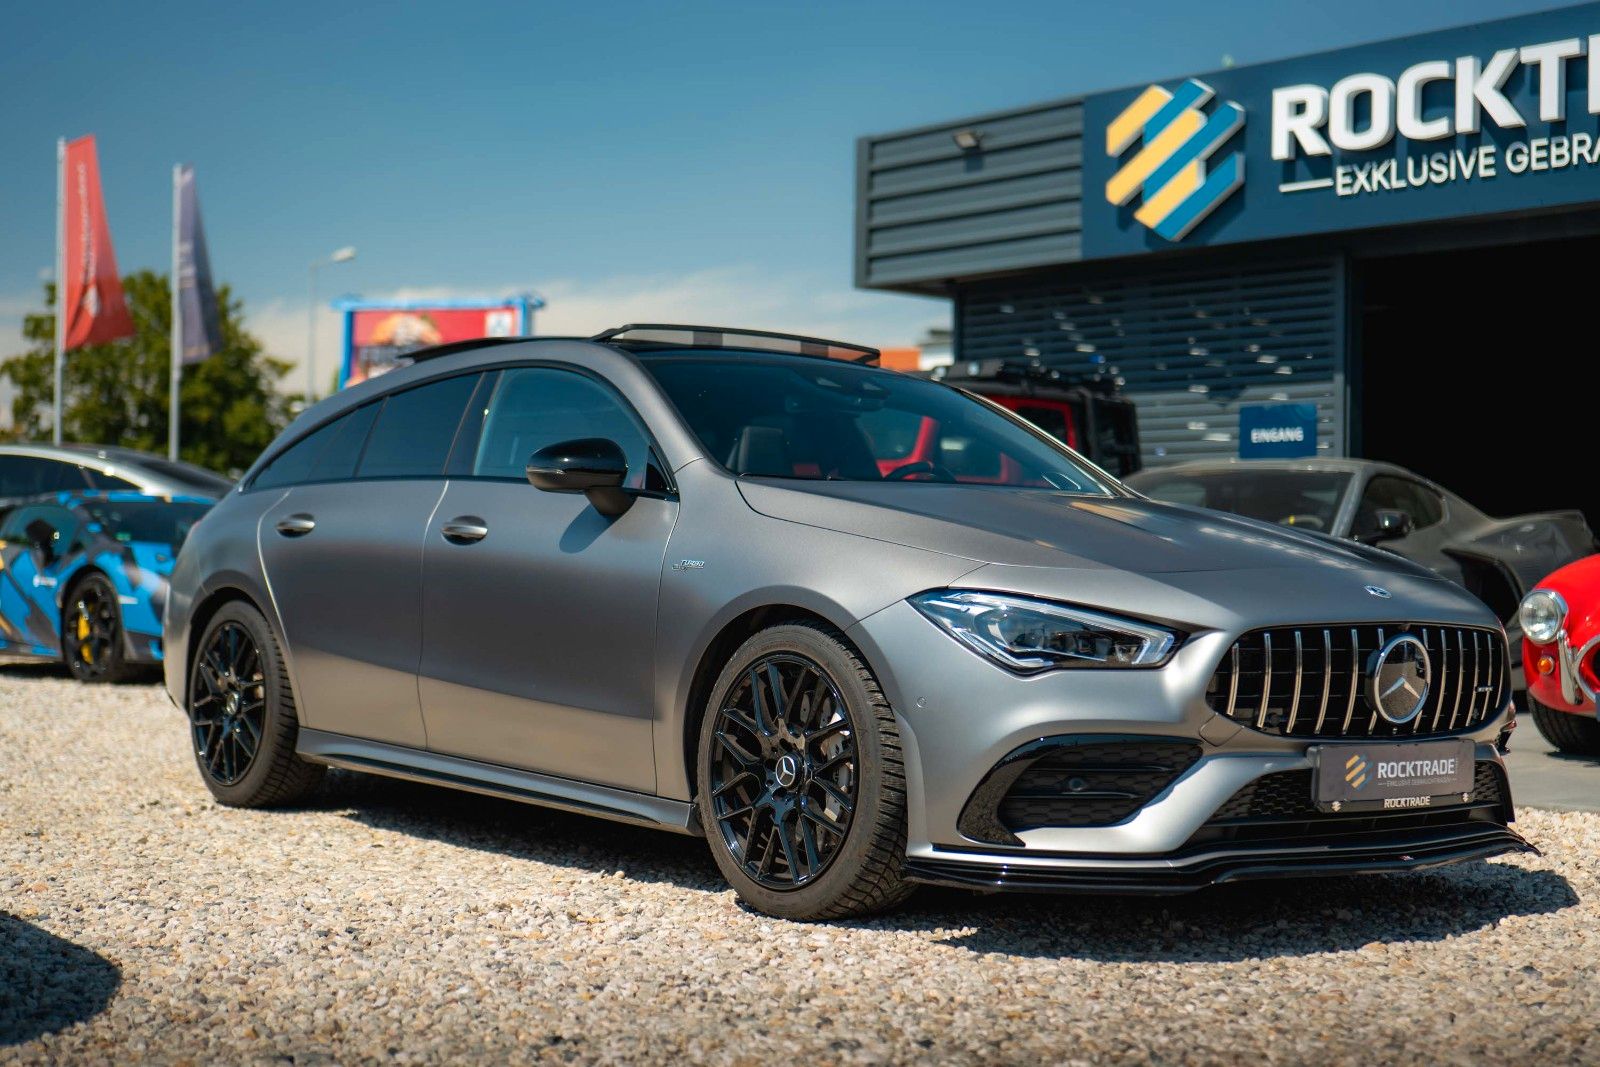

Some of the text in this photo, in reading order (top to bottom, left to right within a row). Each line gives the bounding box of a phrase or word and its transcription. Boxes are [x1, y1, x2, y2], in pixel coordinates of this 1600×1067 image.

[1271, 34, 1600, 160] ROCKT
[1335, 144, 1497, 197] EXKLUSIVE
[1251, 427, 1304, 443] EINGANG
[1377, 758, 1455, 779] ROCKTRADE
[1384, 796, 1430, 808] ROCKTRADE
